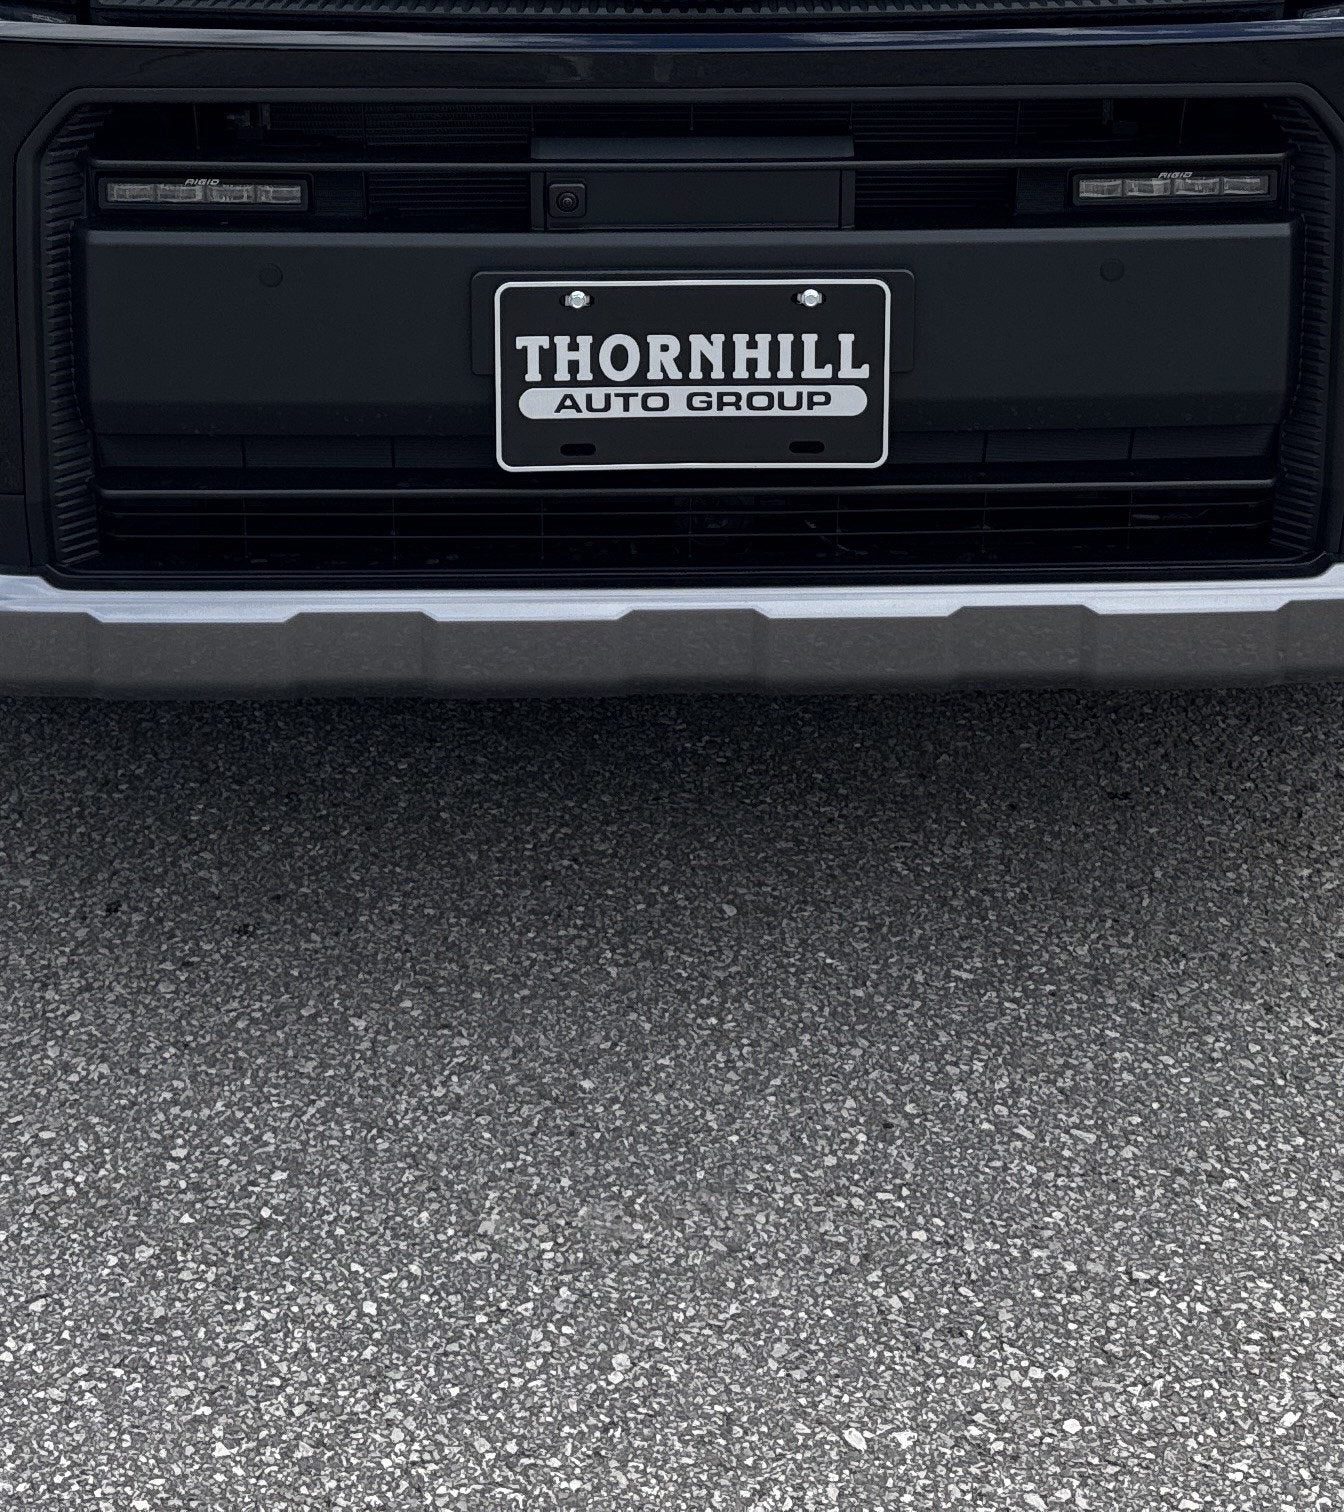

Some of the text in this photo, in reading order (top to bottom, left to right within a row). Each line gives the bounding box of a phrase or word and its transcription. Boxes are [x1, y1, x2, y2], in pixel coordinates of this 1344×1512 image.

[184, 178, 220, 186] RIGID
[1157, 171, 1194, 179] RIGID
[516, 333, 870, 382] THORNHILL
[554, 390, 832, 414] AUTO GROUP
